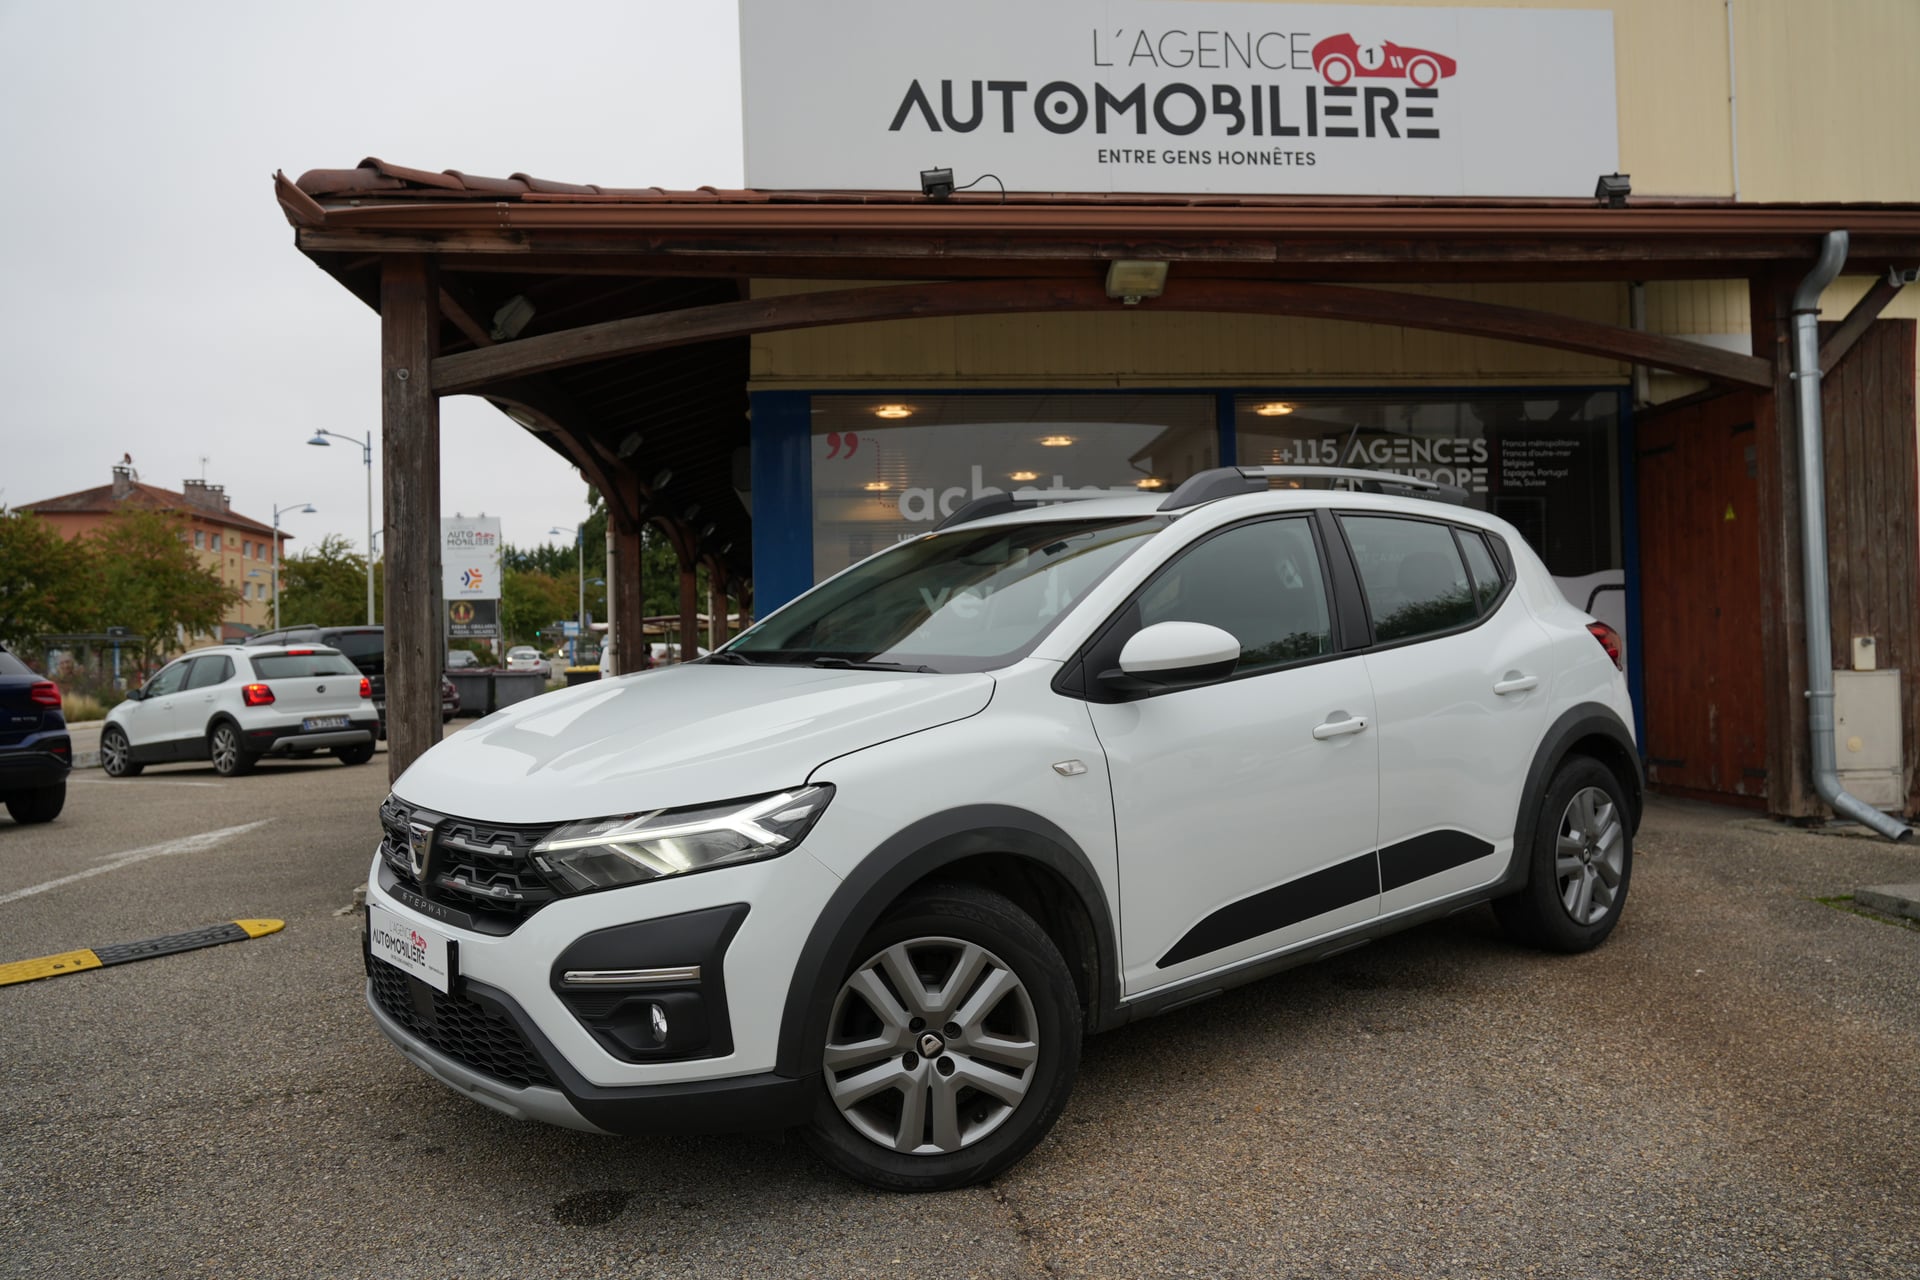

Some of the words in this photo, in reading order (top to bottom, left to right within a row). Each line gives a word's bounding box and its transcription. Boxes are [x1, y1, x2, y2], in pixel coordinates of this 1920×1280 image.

[1093, 29, 1312, 70] L'AGENCE
[1364, 47, 1376, 65] 1
[1098, 149, 1156, 164] ENTRE
[1162, 150, 1213, 165] GENS
[1218, 147, 1316, 167] HONNÊTES
[1279, 438, 1339, 464] +115
[1347, 438, 1488, 464] AGENCES
[1502, 449, 1527, 457] France
[1502, 459, 1535, 469] Belgique
[1537, 468, 1568, 479] Portugal
[402, 893, 448, 918] STEPWAY
